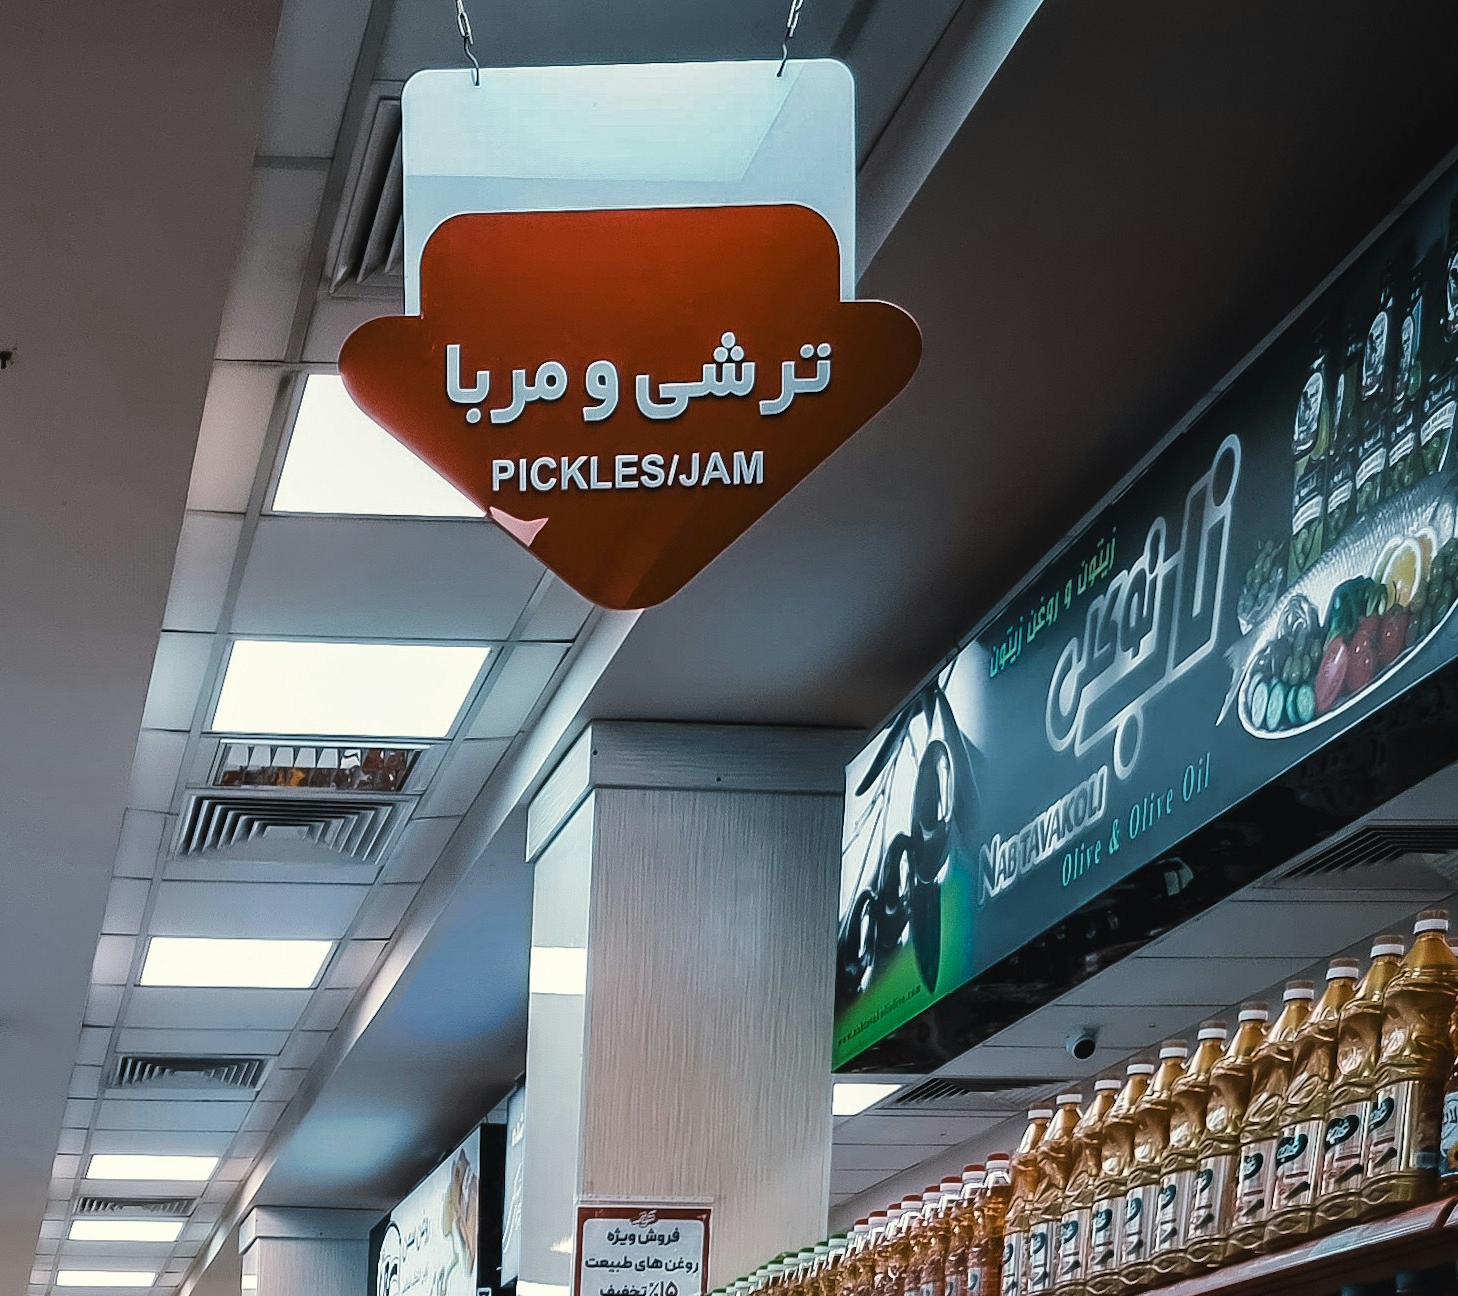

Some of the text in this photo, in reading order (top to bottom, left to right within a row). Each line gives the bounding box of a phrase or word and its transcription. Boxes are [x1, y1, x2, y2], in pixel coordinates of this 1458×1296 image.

[446, 332, 831, 424] ترشی و مربا
[492, 451, 764, 491] PICKLES/JAM
[1062, 751, 1211, 887] Olive & Olive Oil
[606, 1227, 680, 1246] فروش ویژه
[585, 1255, 699, 1273] روغن های طبیعت
